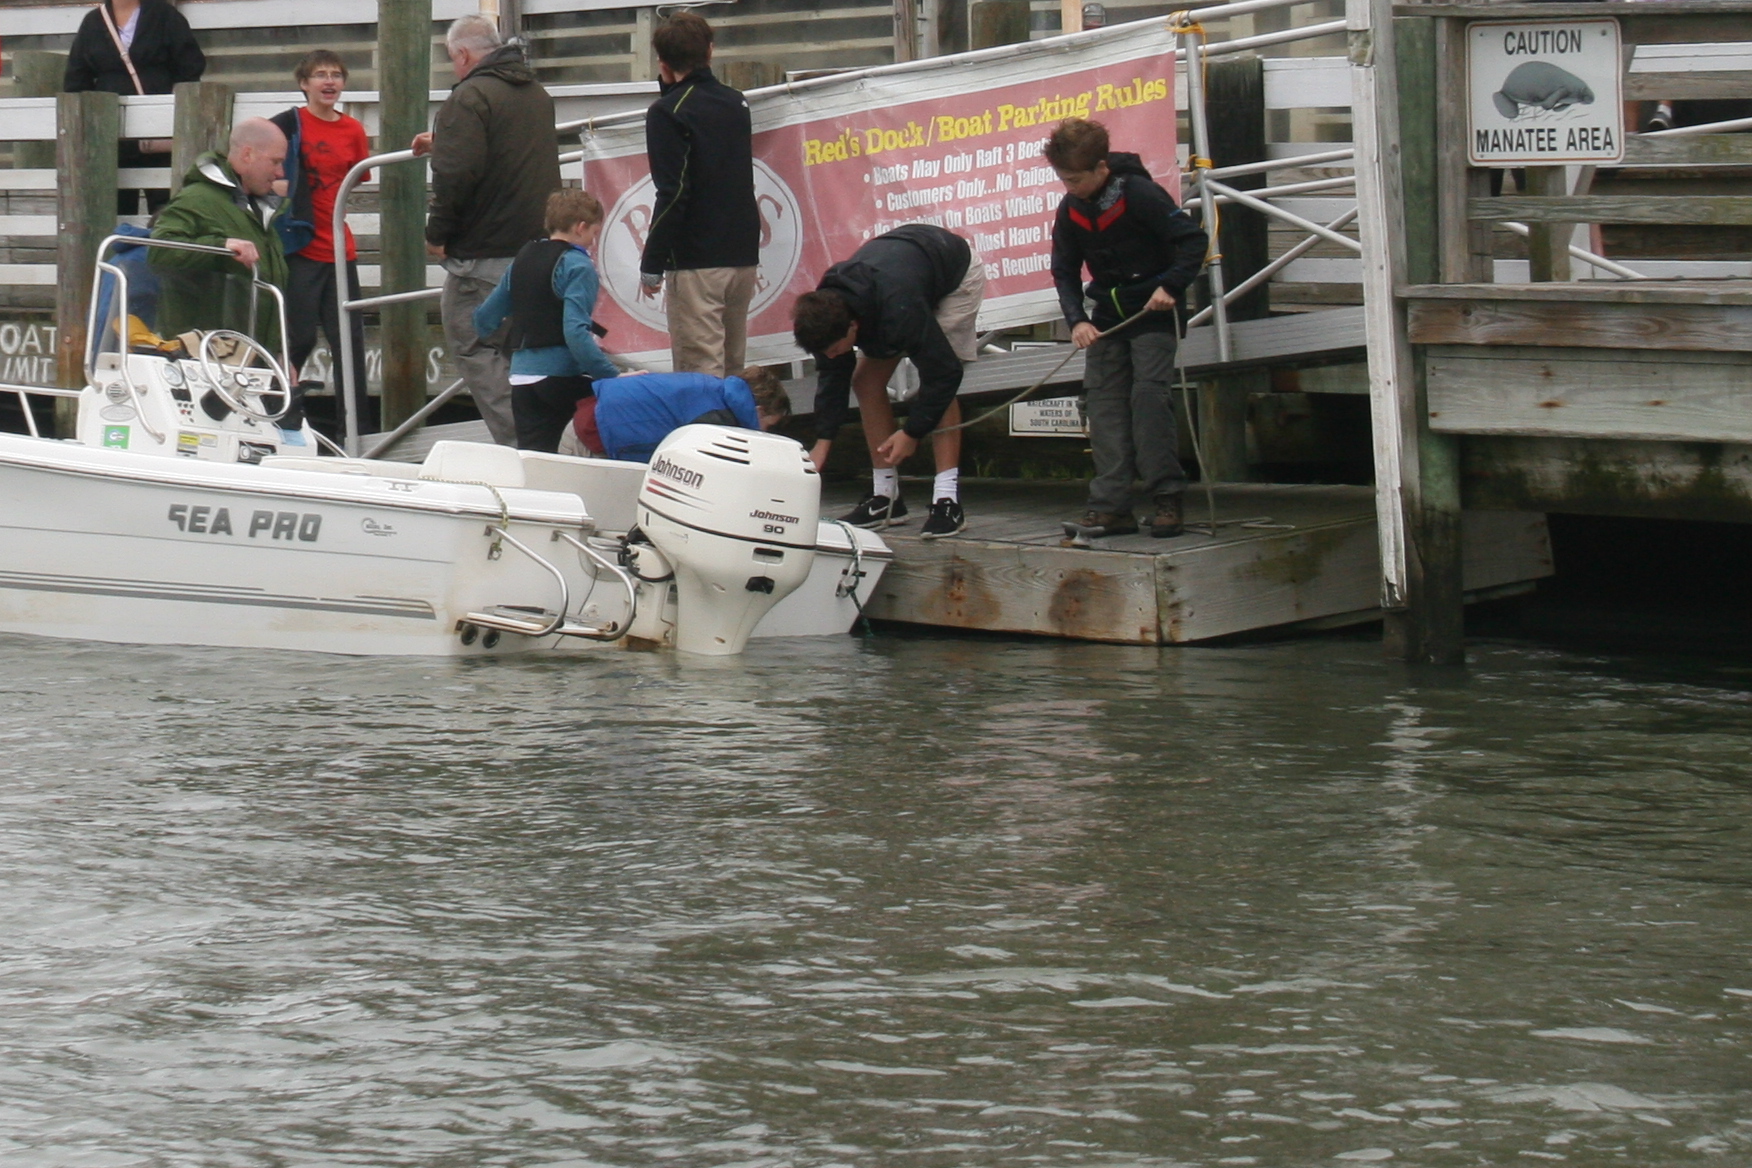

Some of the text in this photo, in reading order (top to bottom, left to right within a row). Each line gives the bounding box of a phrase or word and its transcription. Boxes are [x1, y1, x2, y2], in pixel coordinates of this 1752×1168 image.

[1504, 29, 1582, 55] CAUTION
[803, 128, 861, 166] Red's
[997, 91, 1093, 132] Parking
[1095, 77, 1167, 112] Rules
[1476, 127, 1615, 153] MANATEE AREA
[873, 137, 1052, 186] Boats May Only Raft 3 Boat
[886, 185, 953, 211] Customers
[947, 209, 962, 229] On
[965, 203, 1002, 224] Boats
[1005, 195, 1043, 218] While
[973, 230, 1006, 252] Must
[1008, 226, 1040, 247] Have
[1001, 252, 1052, 277] Require
[1029, 418, 1049, 427] SOUTH
[651, 454, 705, 488] Johnson
[168, 503, 322, 542] SEA PRO
[749, 509, 799, 524] Johnson
[763, 524, 784, 534] 90
